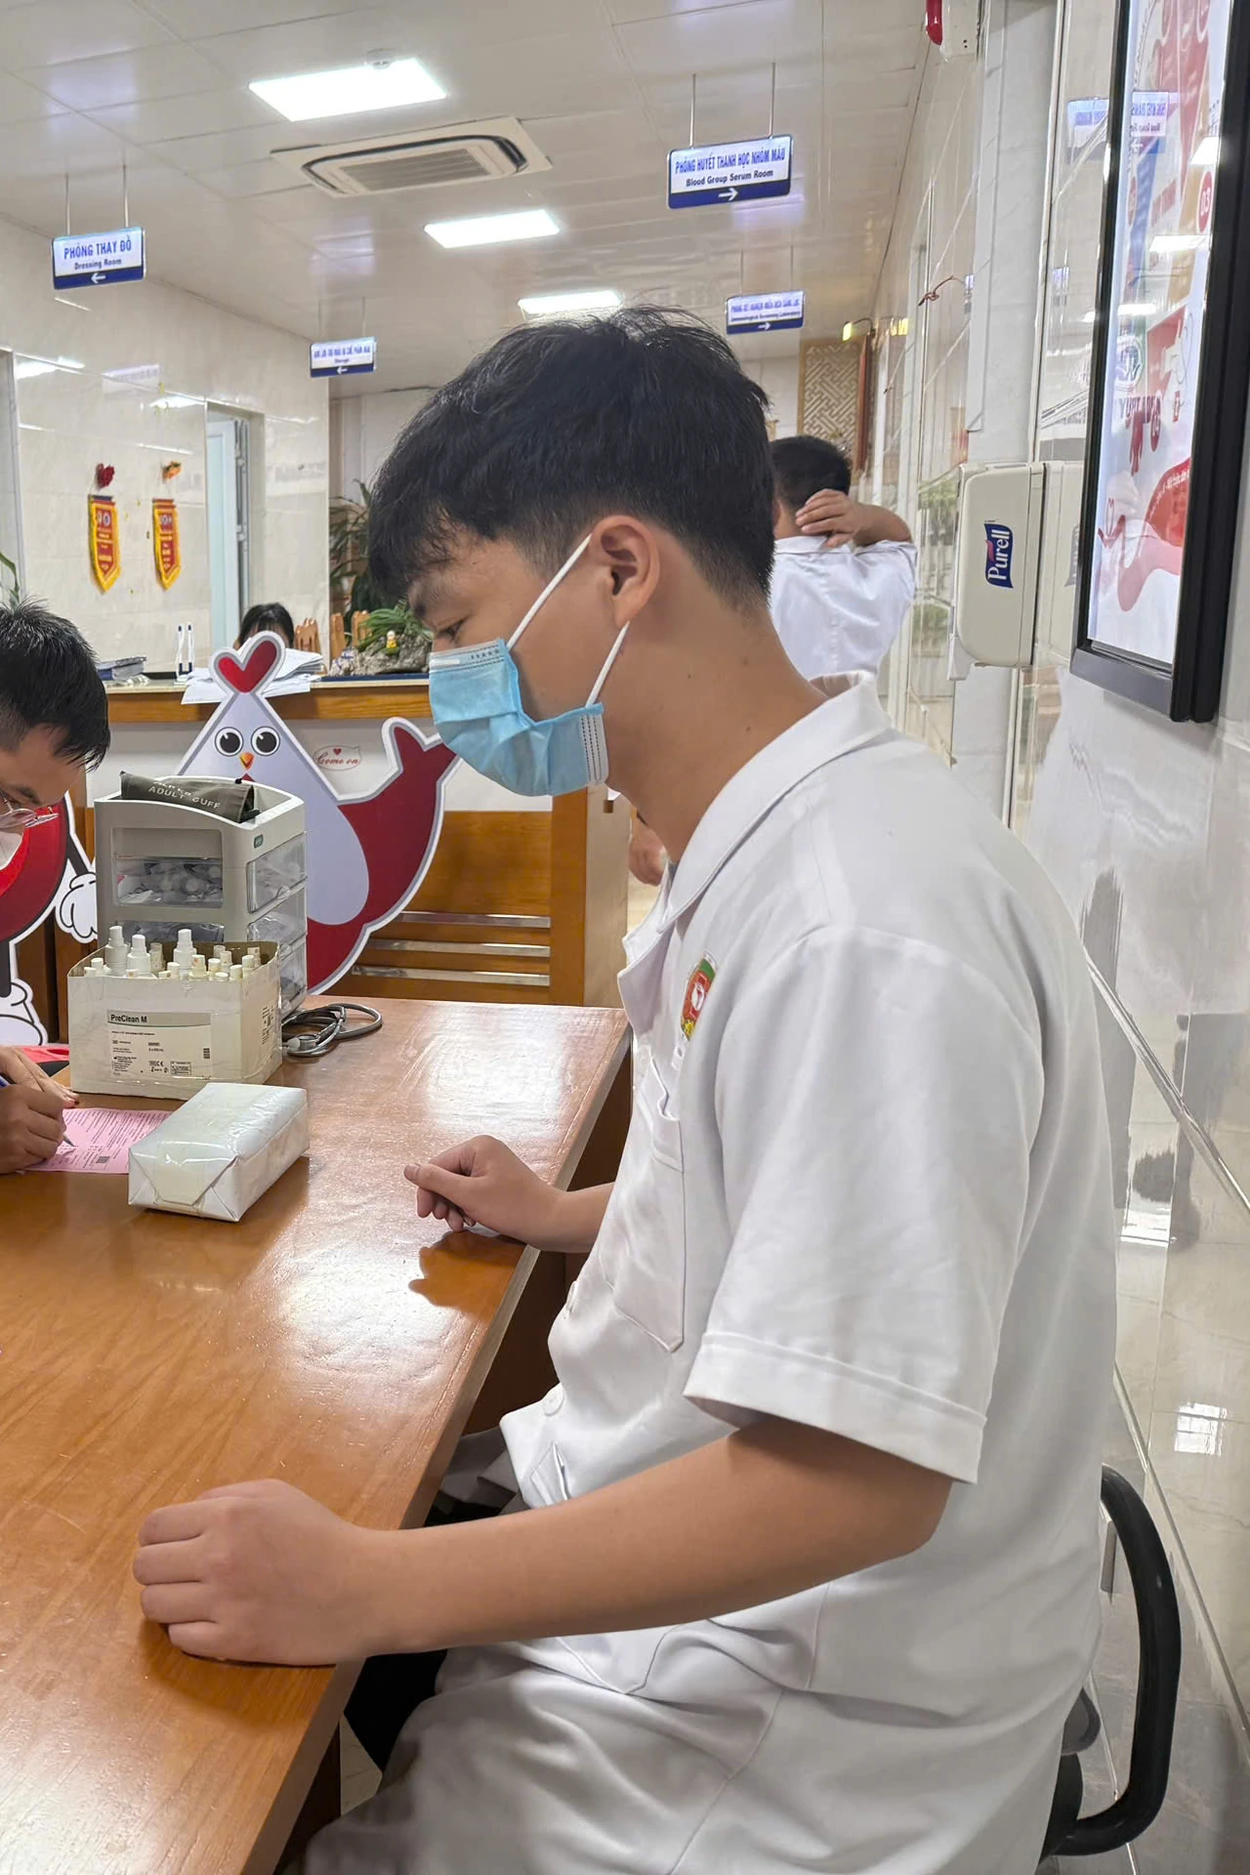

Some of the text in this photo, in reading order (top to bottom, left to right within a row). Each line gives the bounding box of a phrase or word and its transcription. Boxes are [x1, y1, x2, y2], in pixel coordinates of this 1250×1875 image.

[675, 145, 786, 174] PHÒNG HUYẾT THANH HỌC NHÓM MÁU
[686, 169, 773, 187] Blood Group Serum Room
[64, 235, 132, 259] PHÒNG THAY ĐỒ
[74, 258, 122, 270] Dressing Room
[987, 529, 1010, 580] Purell
[315, 751, 344, 765] Come
[148, 786, 185, 799] ADULT
[110, 1014, 140, 1023] PreClean
